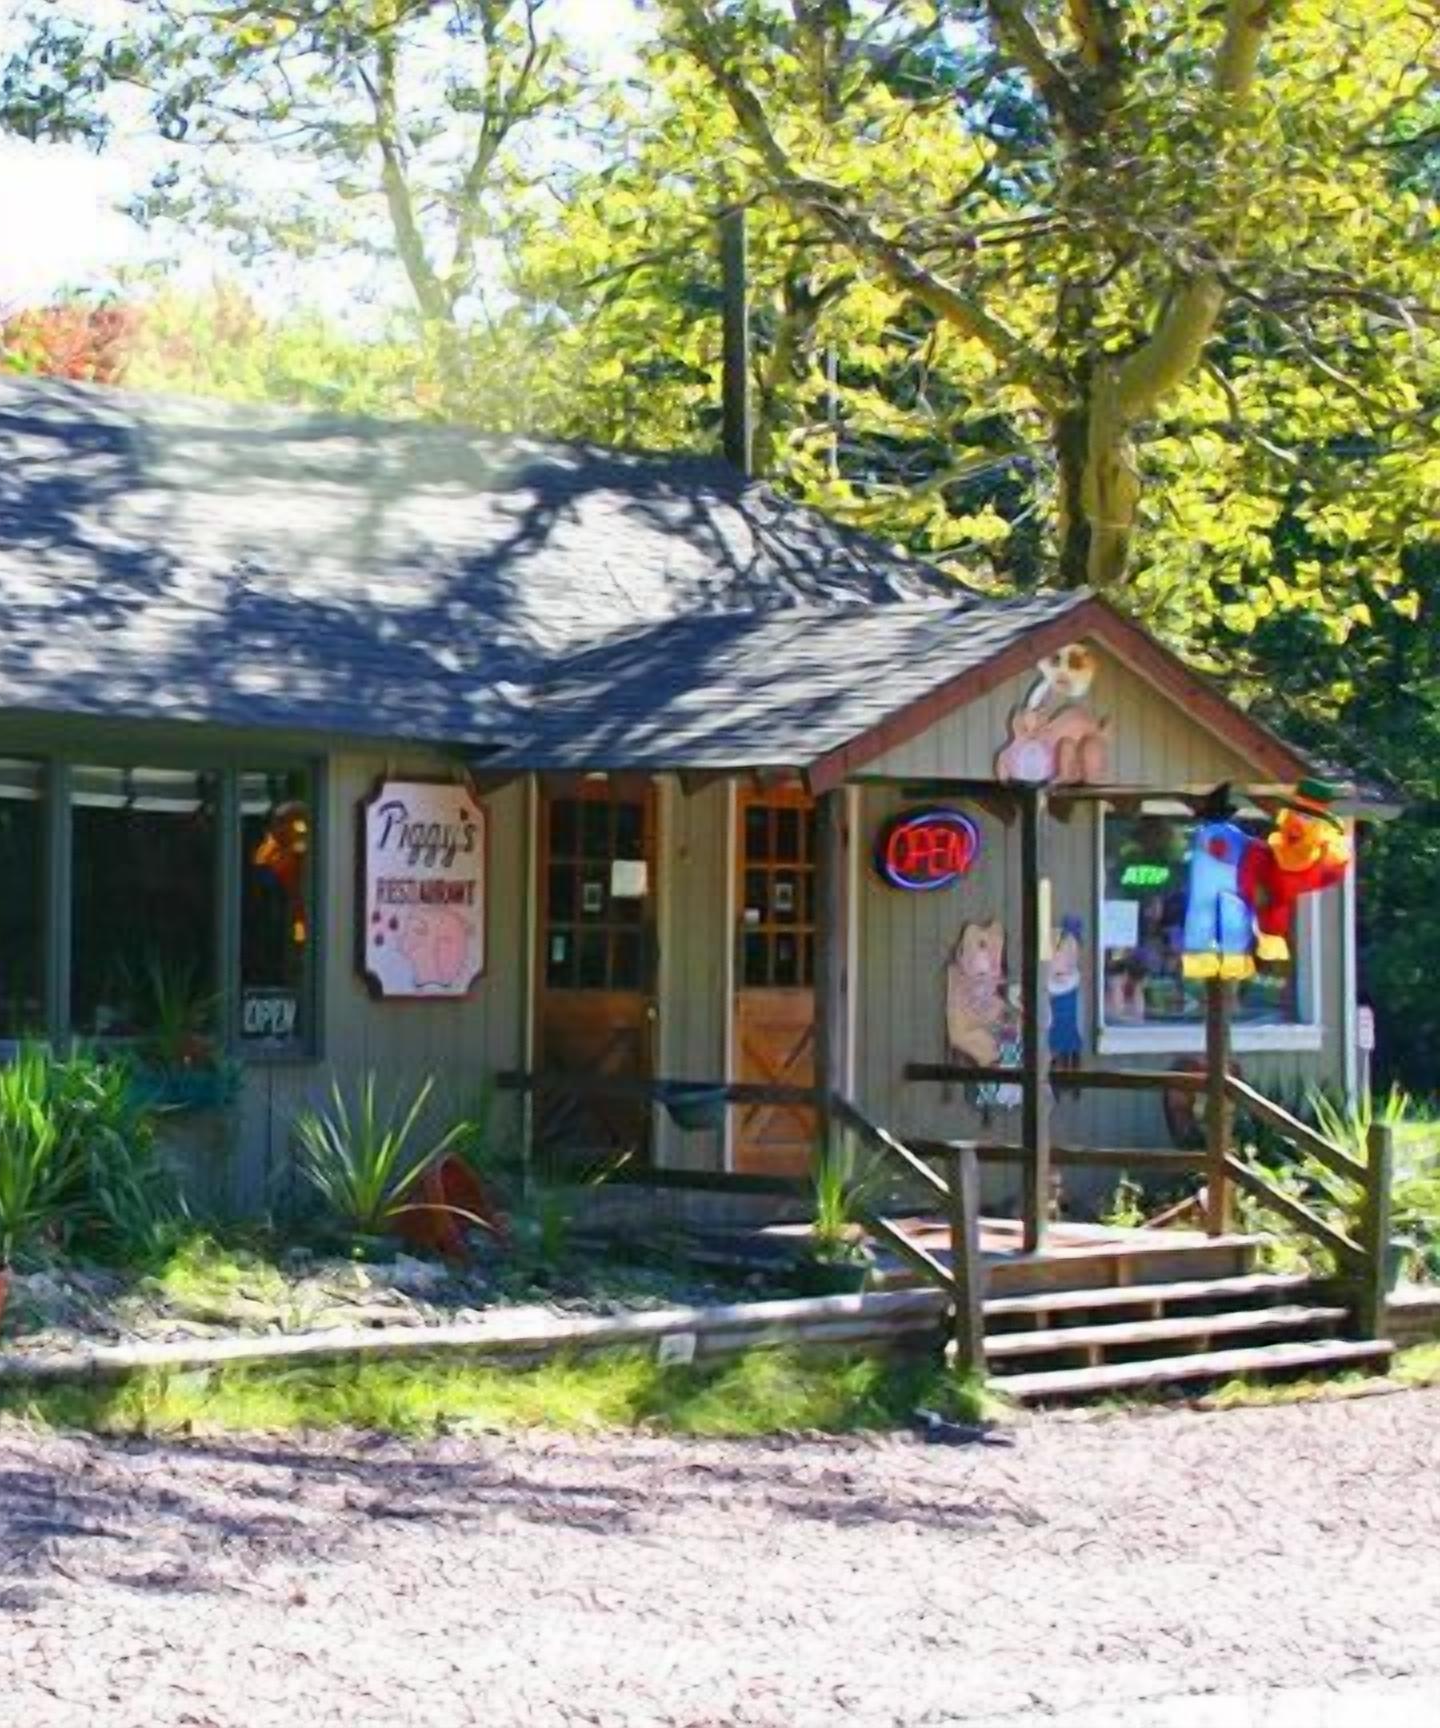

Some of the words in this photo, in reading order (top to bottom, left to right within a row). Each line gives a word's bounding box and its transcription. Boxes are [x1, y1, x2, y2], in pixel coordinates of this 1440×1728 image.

[377, 801, 477, 868] Piggy's
[888, 826, 970, 876] OPEN
[376, 879, 476, 905] RESTAURANT
[243, 999, 296, 1033] OPEN
